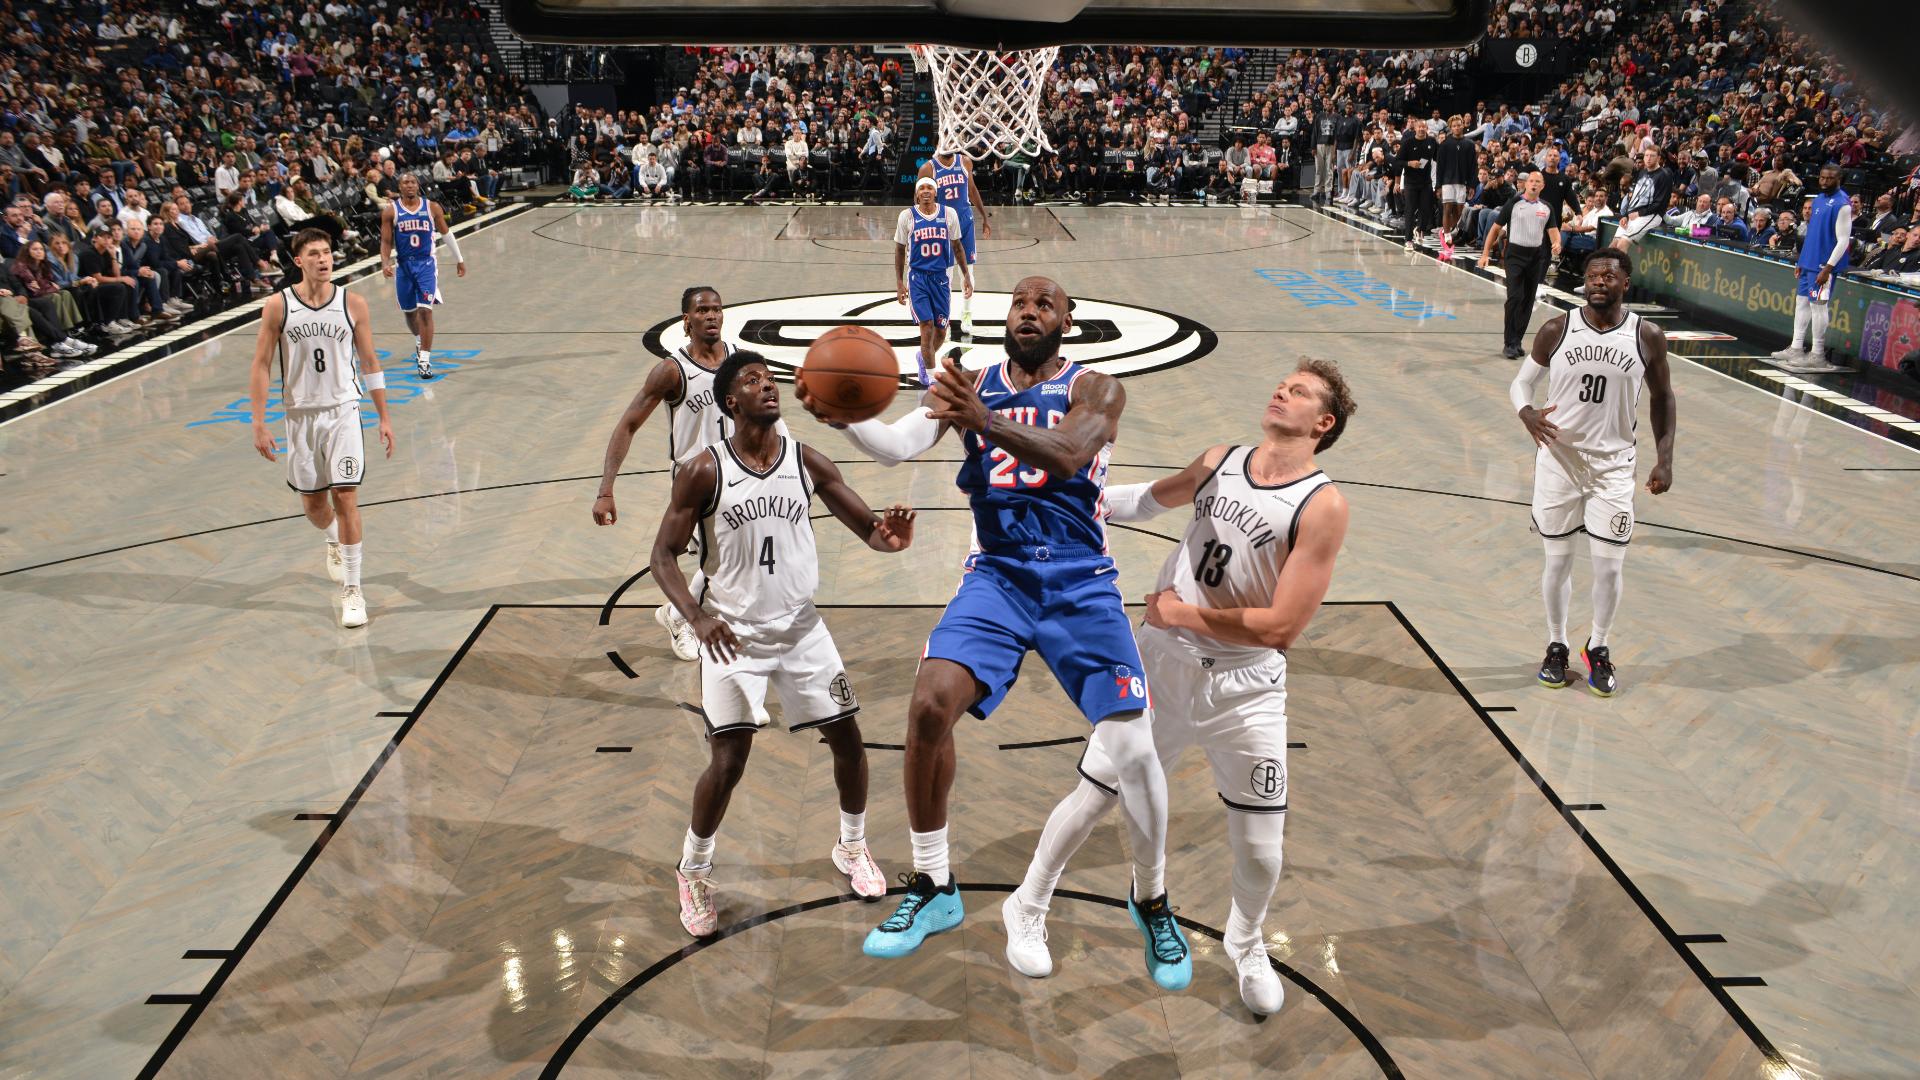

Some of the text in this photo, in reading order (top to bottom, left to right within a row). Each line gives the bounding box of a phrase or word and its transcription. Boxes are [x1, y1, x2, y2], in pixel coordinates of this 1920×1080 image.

[945, 187, 959, 200] 21
[410, 234, 421, 248] 0
[921, 243, 942, 257] 00
[1681, 258, 1711, 291] The
[1713, 267, 1747, 302] feel
[1747, 282, 1796, 317] good
[287, 322, 348, 344] BROOKLYN
[314, 348, 326, 373] 8
[1565, 345, 1636, 373] BROOKLYN
[1041, 383, 1068, 391] Bloom
[1579, 373, 1607, 404] 30
[722, 495, 805, 530] BROOKLYN
[1195, 495, 1276, 549] BROOKLYN
[759, 536, 776, 575] 4
[1194, 539, 1233, 588] 13
[1115, 677, 1145, 698] 76
